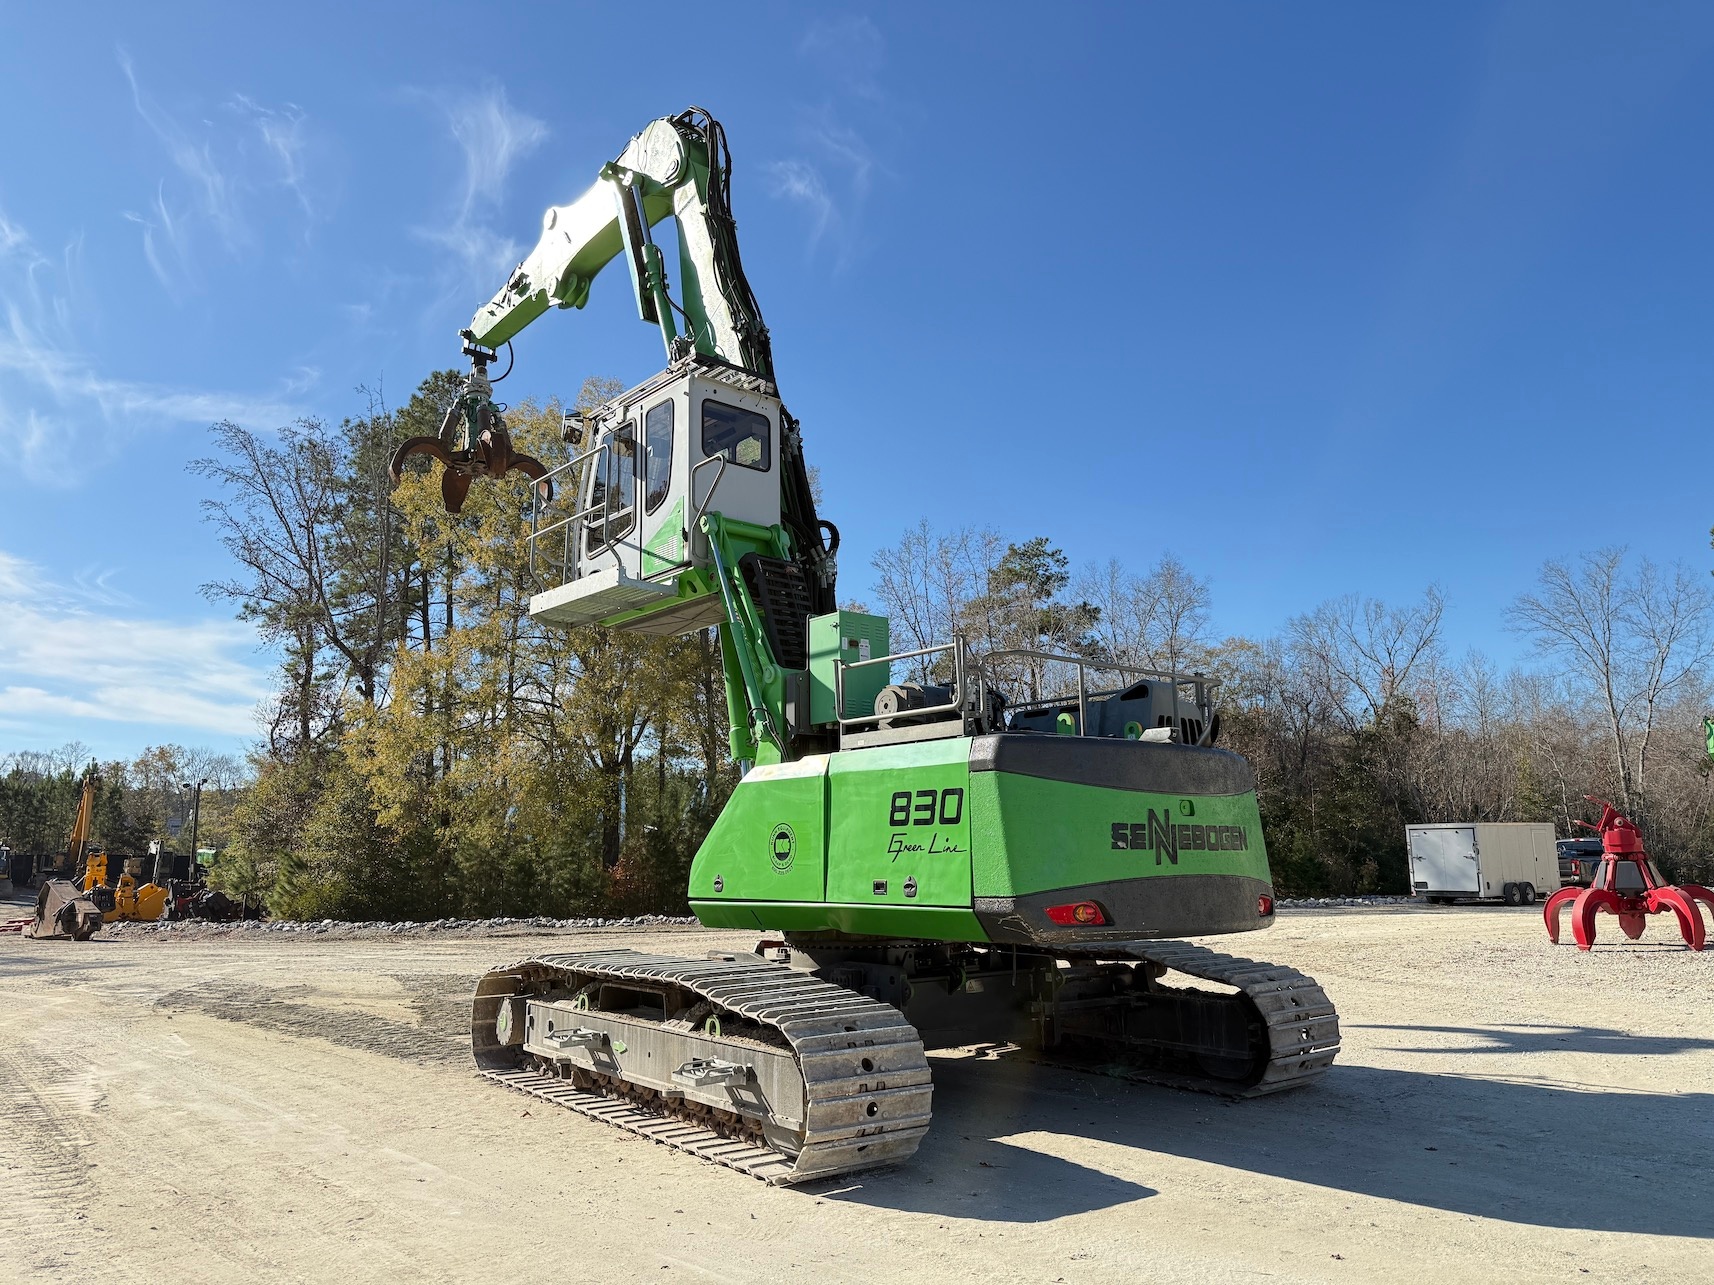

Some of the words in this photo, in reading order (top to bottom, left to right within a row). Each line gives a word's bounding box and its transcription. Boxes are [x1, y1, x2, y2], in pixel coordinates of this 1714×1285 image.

[889, 788, 964, 827] 830
[887, 833, 925, 863] Green
[928, 833, 967, 854] Line
[1111, 808, 1249, 865] SENNEBOGEN
